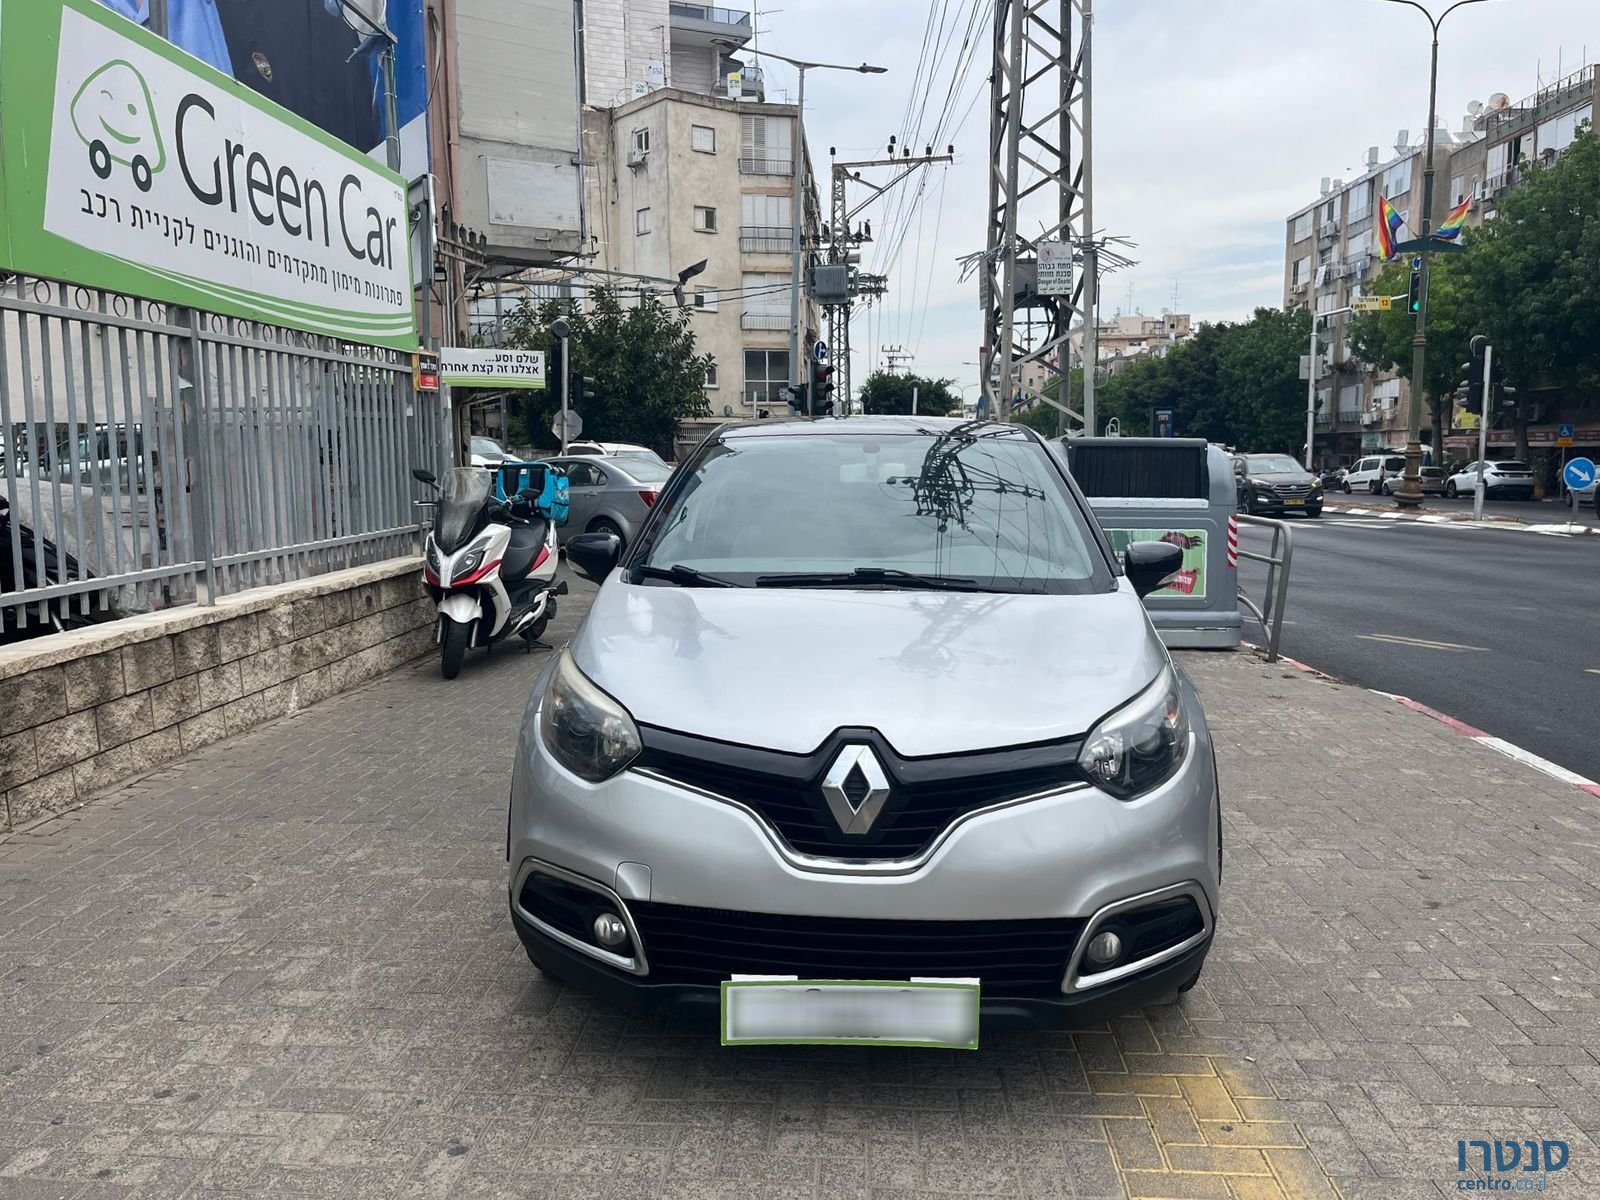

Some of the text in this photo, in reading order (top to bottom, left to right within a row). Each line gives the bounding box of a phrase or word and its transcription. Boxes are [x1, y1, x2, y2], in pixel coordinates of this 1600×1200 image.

[175, 93, 397, 271] Green Car
[80, 188, 403, 306] פתרונות מימון מתקדמים והוגנים לקניית רכב
[516, 353, 539, 363] שלם
[472, 364, 494, 375] קצת
[497, 365, 508, 374] זה
[511, 364, 539, 374] אצלנו
